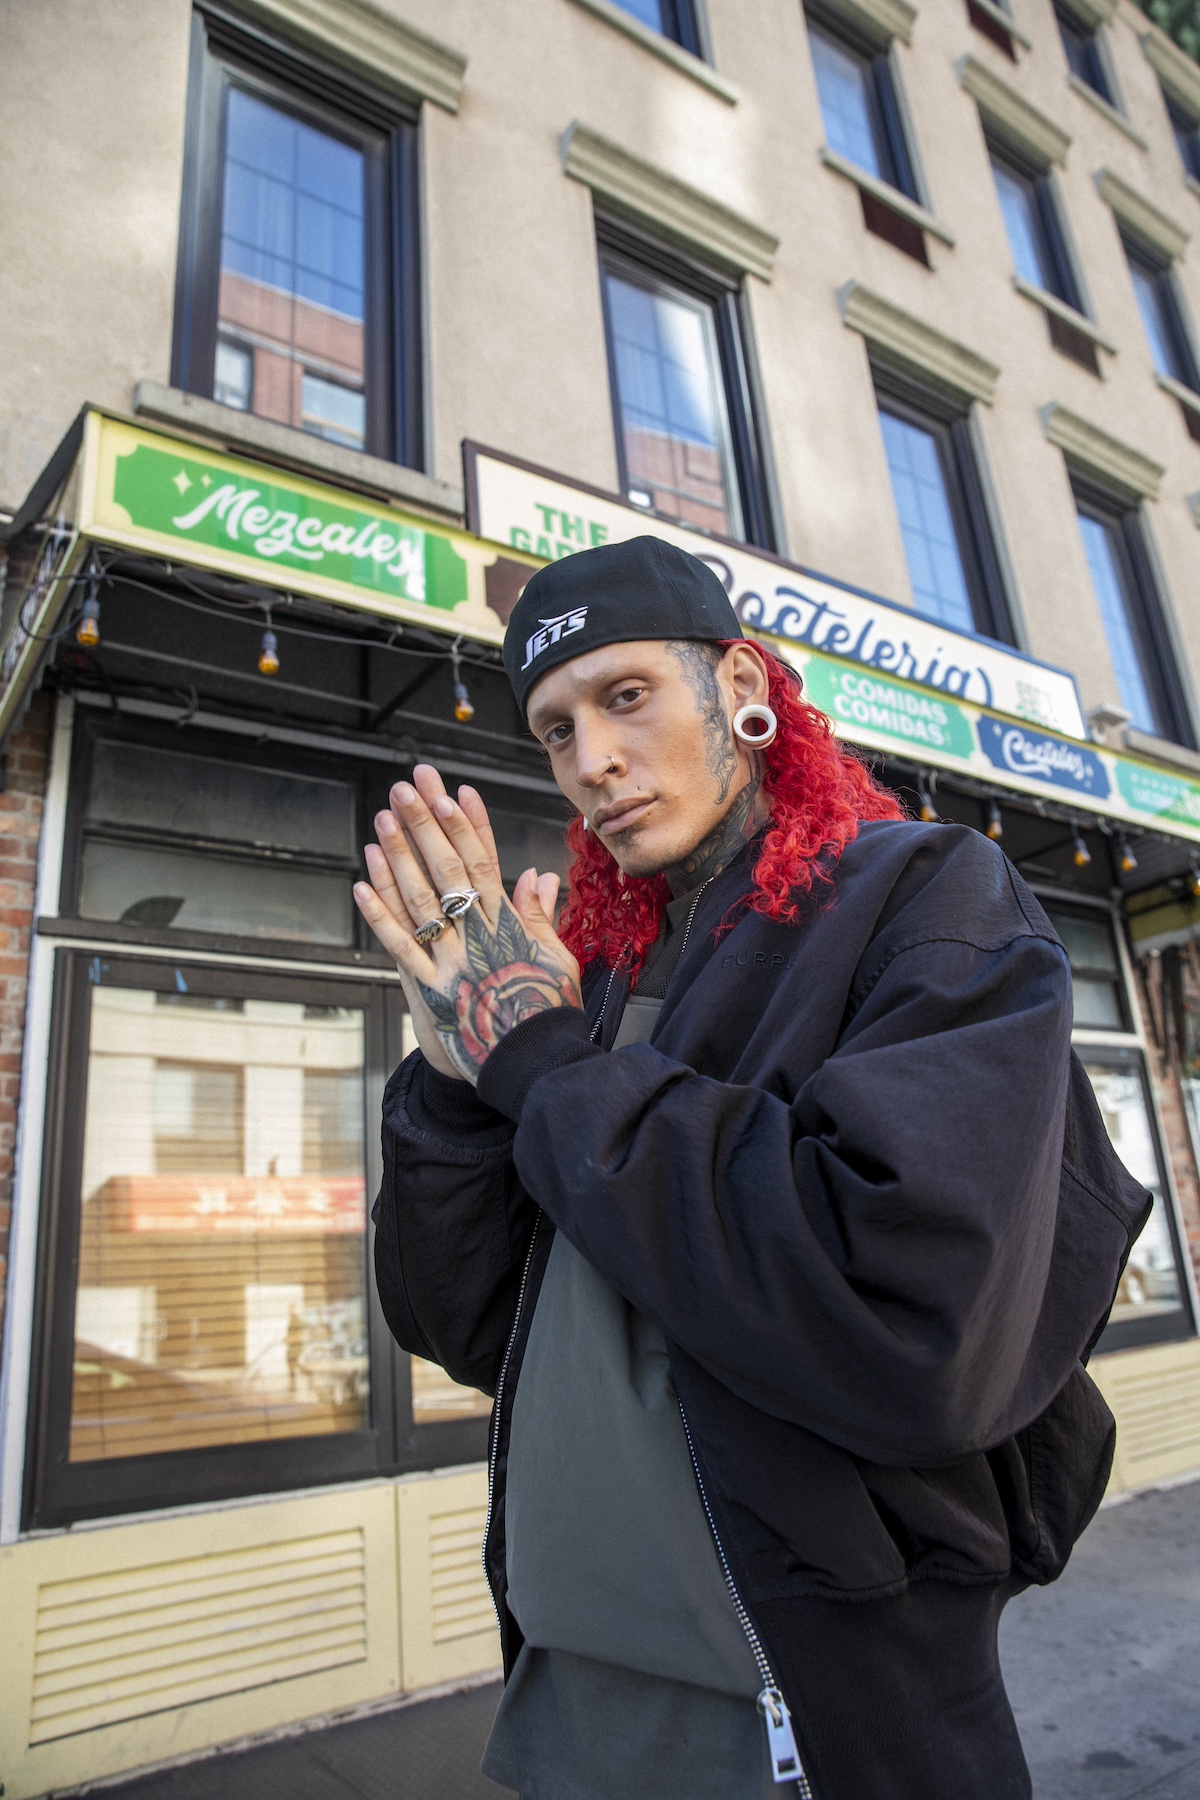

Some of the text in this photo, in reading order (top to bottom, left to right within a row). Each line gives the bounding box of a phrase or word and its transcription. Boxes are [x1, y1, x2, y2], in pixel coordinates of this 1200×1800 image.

[172, 484, 416, 577] Mezcales
[534, 502, 608, 547] THE
[521, 605, 588, 671] JETS
[698, 554, 993, 707] octeleria
[834, 693, 944, 746] COMIDAS
[840, 673, 948, 726] COMIDAS
